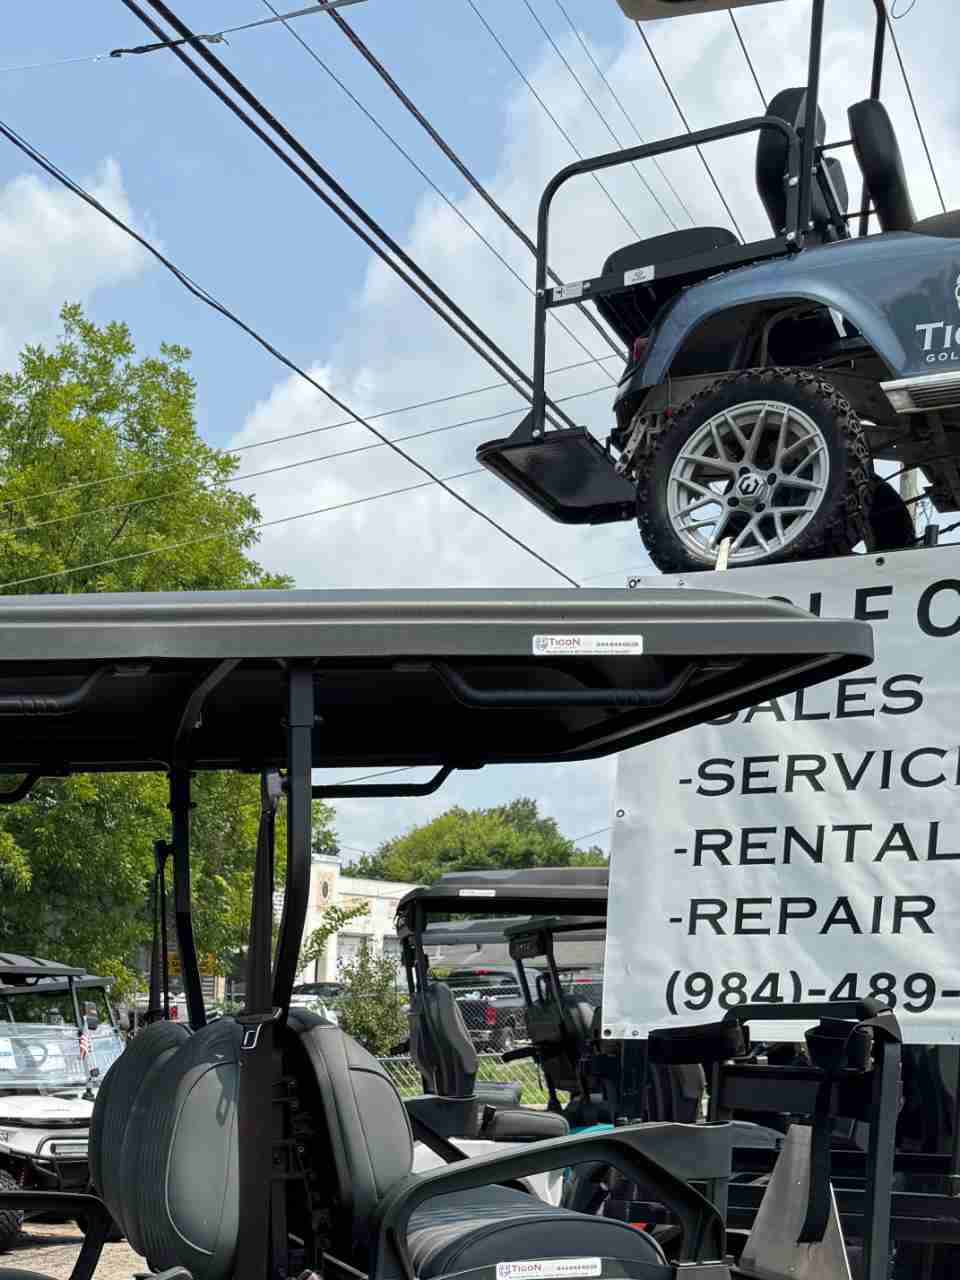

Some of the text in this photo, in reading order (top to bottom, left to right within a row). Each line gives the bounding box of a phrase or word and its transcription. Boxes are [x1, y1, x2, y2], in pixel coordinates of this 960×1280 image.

[705, 674, 924, 726] ALES
[678, 746, 960, 797] -SERVIC
[669, 895, 936, 935] -REPAIR
